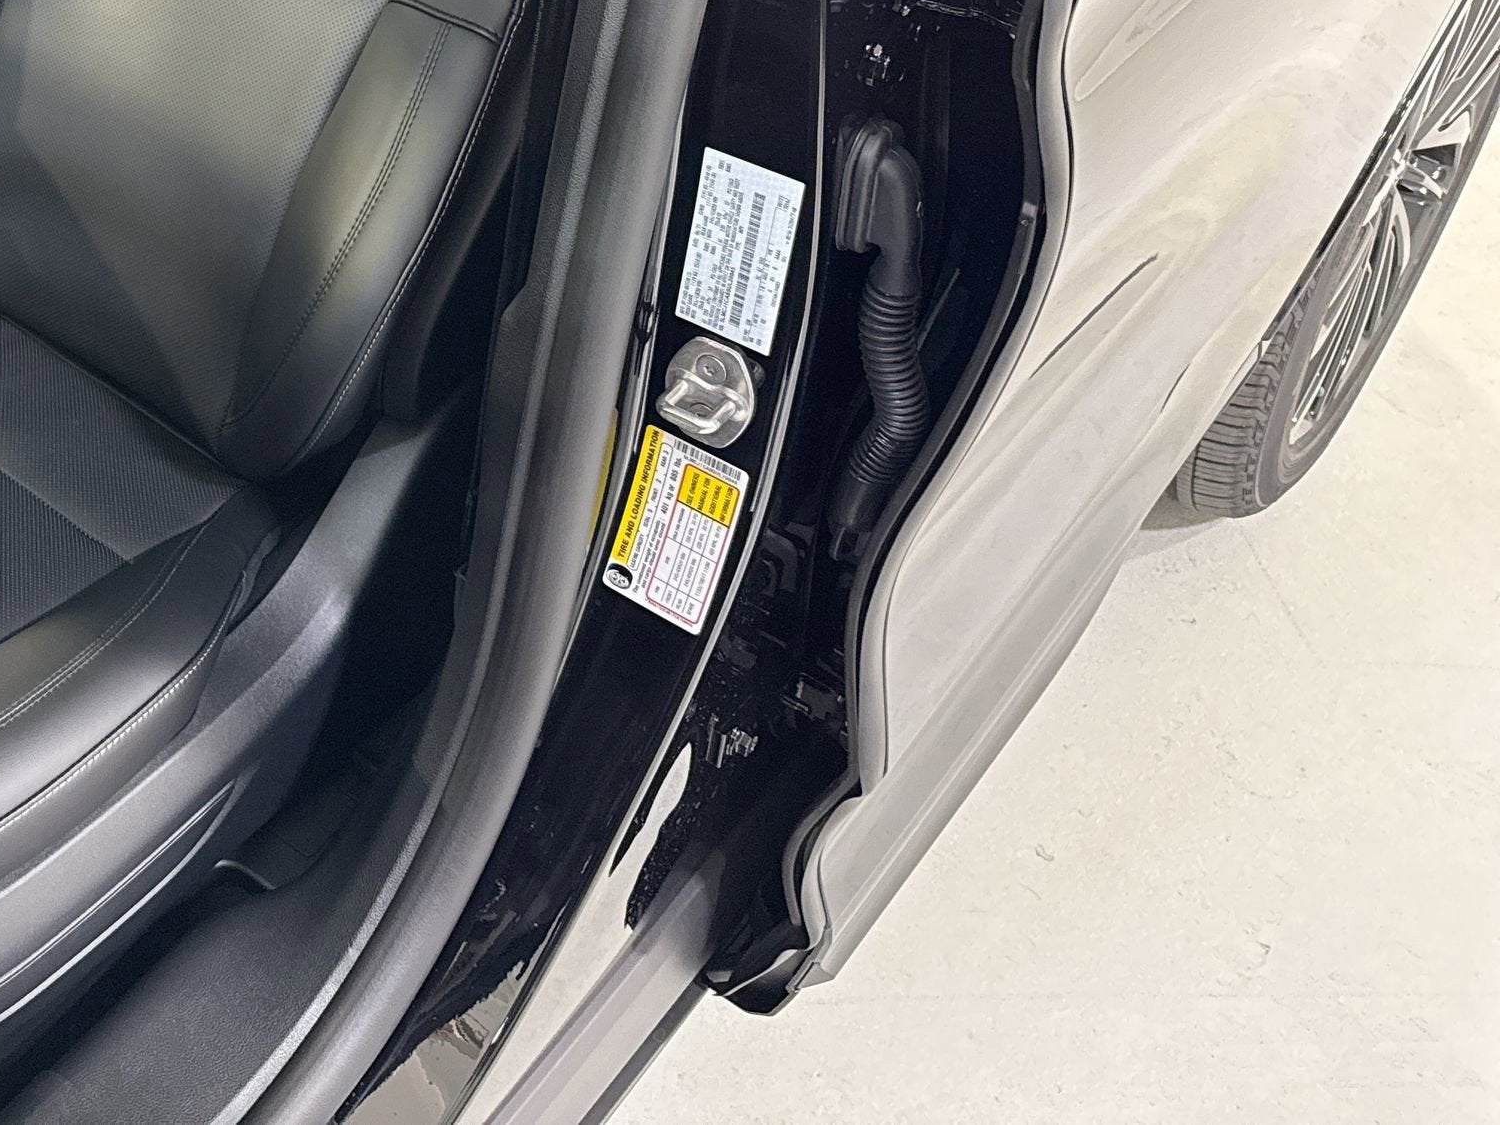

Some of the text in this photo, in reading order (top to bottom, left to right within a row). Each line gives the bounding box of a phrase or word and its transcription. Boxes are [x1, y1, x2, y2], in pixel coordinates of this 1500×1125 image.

[668, 483, 675, 492] or
[702, 476, 711, 489] FOR
[617, 429, 659, 559] TIRE AND LOADING INFORMATION
[664, 490, 674, 501] kg
[685, 493, 693, 505] SEE
[707, 483, 722, 515] ADDITIONAL
[660, 501, 669, 514] 401
[717, 486, 735, 522] INFORMATION
